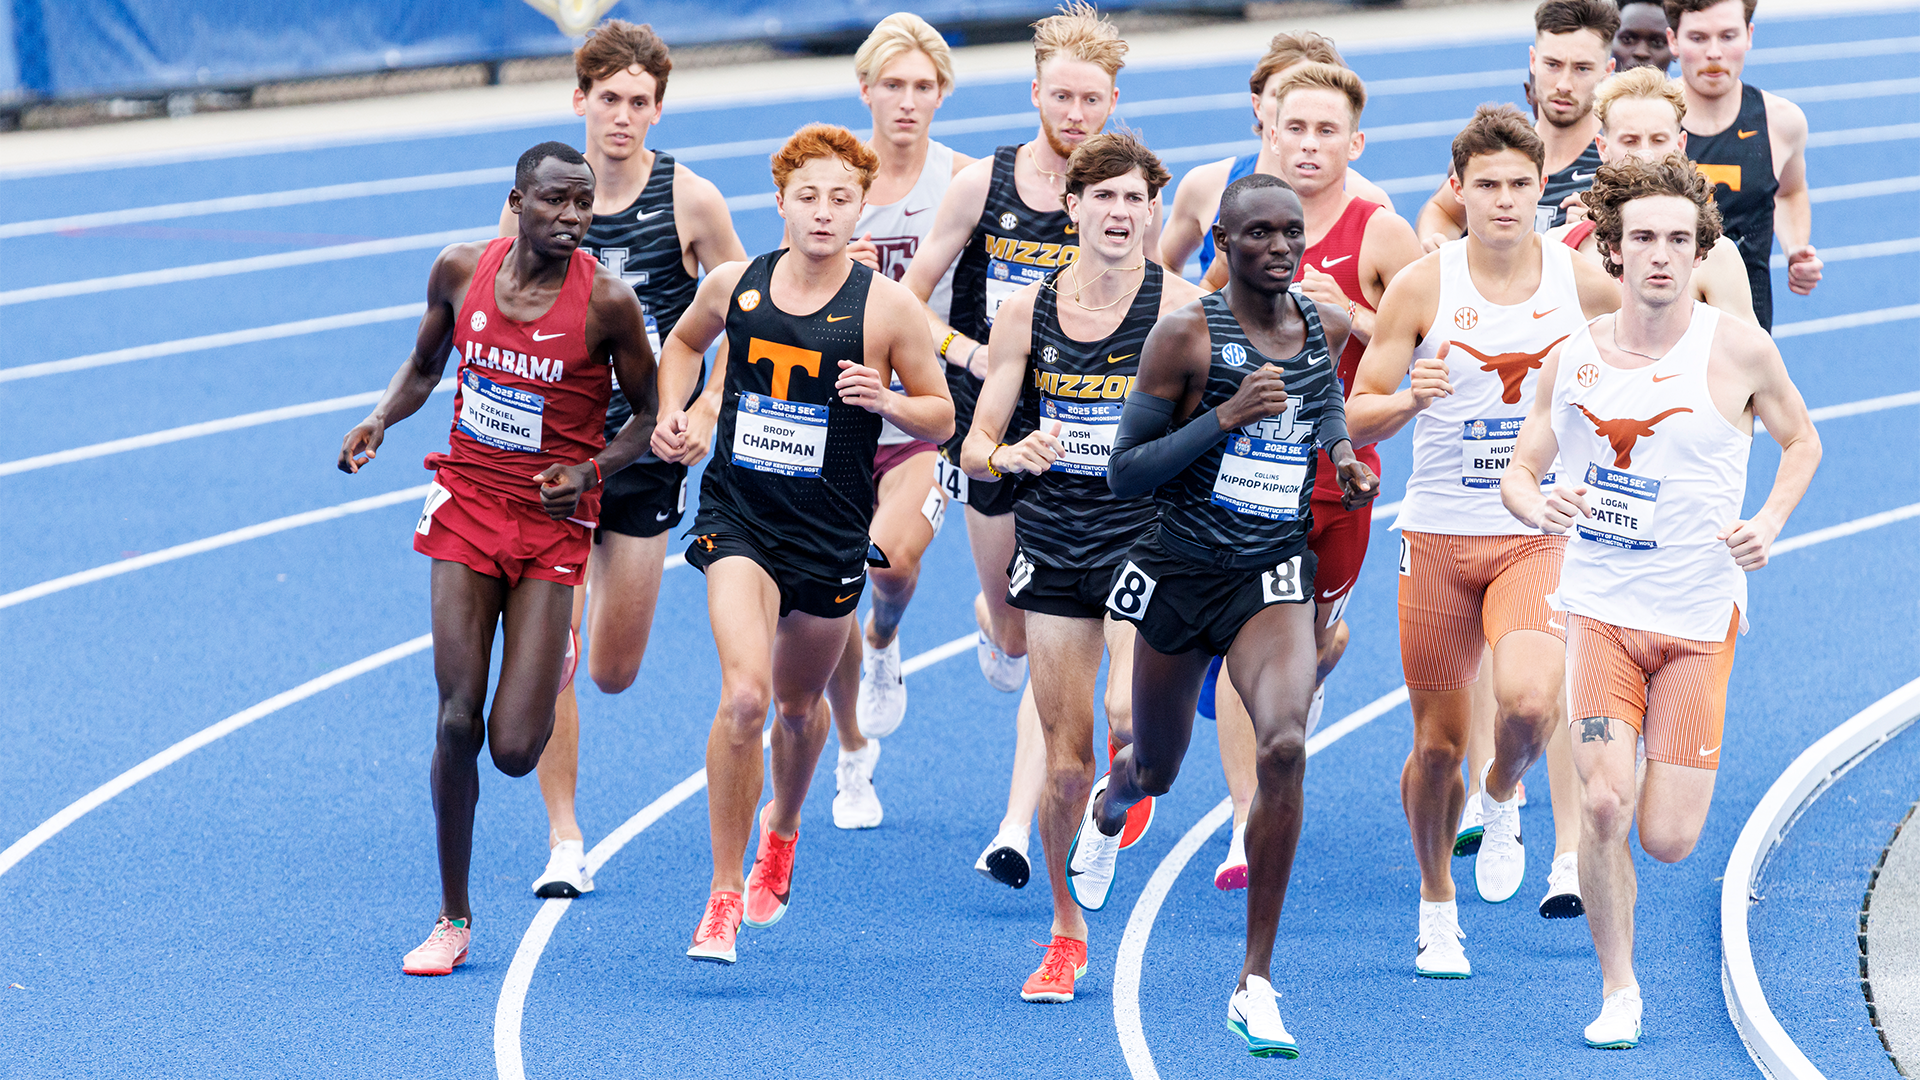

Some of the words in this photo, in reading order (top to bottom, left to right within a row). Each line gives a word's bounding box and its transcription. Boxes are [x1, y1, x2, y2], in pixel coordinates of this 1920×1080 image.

[985, 233, 1080, 267] MIZZO
[1455, 308, 1478, 330] SEC
[466, 340, 564, 382] ALABAMA
[1043, 346, 1058, 362] SEC
[1224, 344, 1244, 364] SEC
[748, 337, 822, 400] T
[1578, 364, 1598, 387] SEC
[480, 388, 501, 400] OUTDOOR
[502, 396, 541, 412] CHAMPIONSHIPS
[491, 384, 513, 398] 2025
[514, 393, 532, 403] SEC
[481, 403, 514, 420] EZEKIEL
[761, 408, 784, 417] OUTDOOR
[785, 413, 826, 423] CHAMPIONSHIPS
[772, 402, 796, 412] 2025
[798, 406, 815, 415] SEC
[1068, 406, 1090, 414] 2025
[469, 406, 530, 438] PITIRENG
[763, 425, 795, 437] BRODY
[1068, 430, 1090, 438] JOSH
[743, 434, 814, 456] CHAPMAN
[1061, 440, 1110, 456] LLISON
[1264, 443, 1288, 454] 2025
[1491, 445, 1515, 454] HUDS
[735, 454, 764, 465] UNIVERSITY
[1252, 451, 1275, 459] OUTDOOR
[938, 461, 961, 499] 14
[1221, 474, 1261, 488] KIPROP
[1255, 472, 1279, 480] COLLINS
[1607, 473, 1628, 484] 2025
[1630, 478, 1646, 488] SEC
[1598, 480, 1619, 489] OUTDOOR
[1620, 485, 1656, 498] CHAMPIONSHIPS
[1216, 494, 1249, 508] UNIVERSITY
[1601, 498, 1628, 510] LOGAN
[1268, 560, 1296, 596] 8
[1114, 570, 1146, 614] 8
